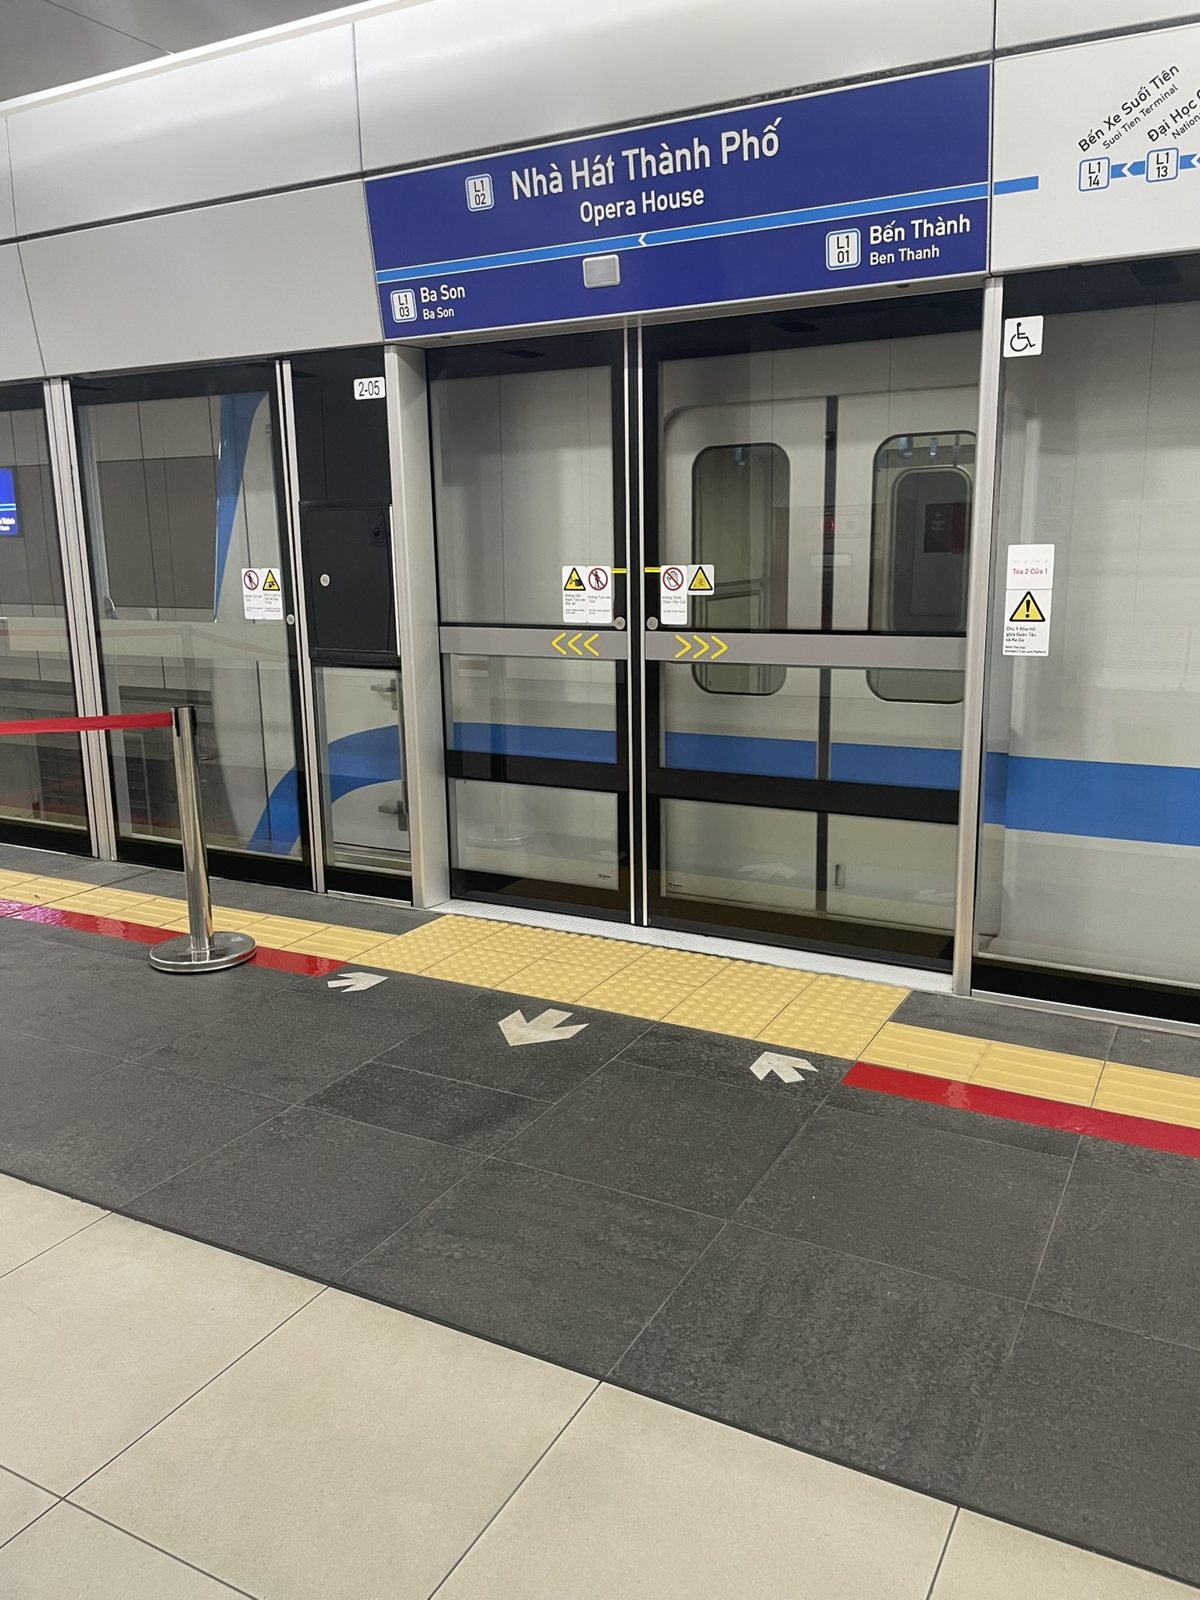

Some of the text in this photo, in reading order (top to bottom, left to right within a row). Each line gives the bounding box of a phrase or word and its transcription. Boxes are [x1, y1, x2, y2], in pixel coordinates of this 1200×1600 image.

[1078, 65, 1180, 152] Bến Xe Suối Tiên
[1102, 130, 1123, 150] Suoi
[1121, 117, 1141, 133] Tien
[1139, 83, 1179, 118] Terminal
[1147, 99, 1198, 142] Đại Học
[1171, 112, 1200, 139] Nation
[511, 116, 783, 200] Nhà Hát Thành Phố
[1156, 152, 1170, 165] L1
[1088, 161, 1101, 174] L1
[1156, 166, 1168, 178] 13
[473, 180, 486, 193] L1
[1088, 175, 1100, 187] 14
[474, 193, 487, 206] 02
[579, 188, 705, 227] Opera House
[869, 213, 971, 245] Bến Thành
[836, 235, 850, 249] L1
[837, 250, 850, 263] 01
[869, 244, 940, 266] Ben Thanh
[397, 294, 409, 306] L1
[420, 284, 466, 303] Ba Son
[399, 306, 410, 317] 03
[422, 307, 455, 320] Ba Son
[358, 380, 380, 396] 2-05
